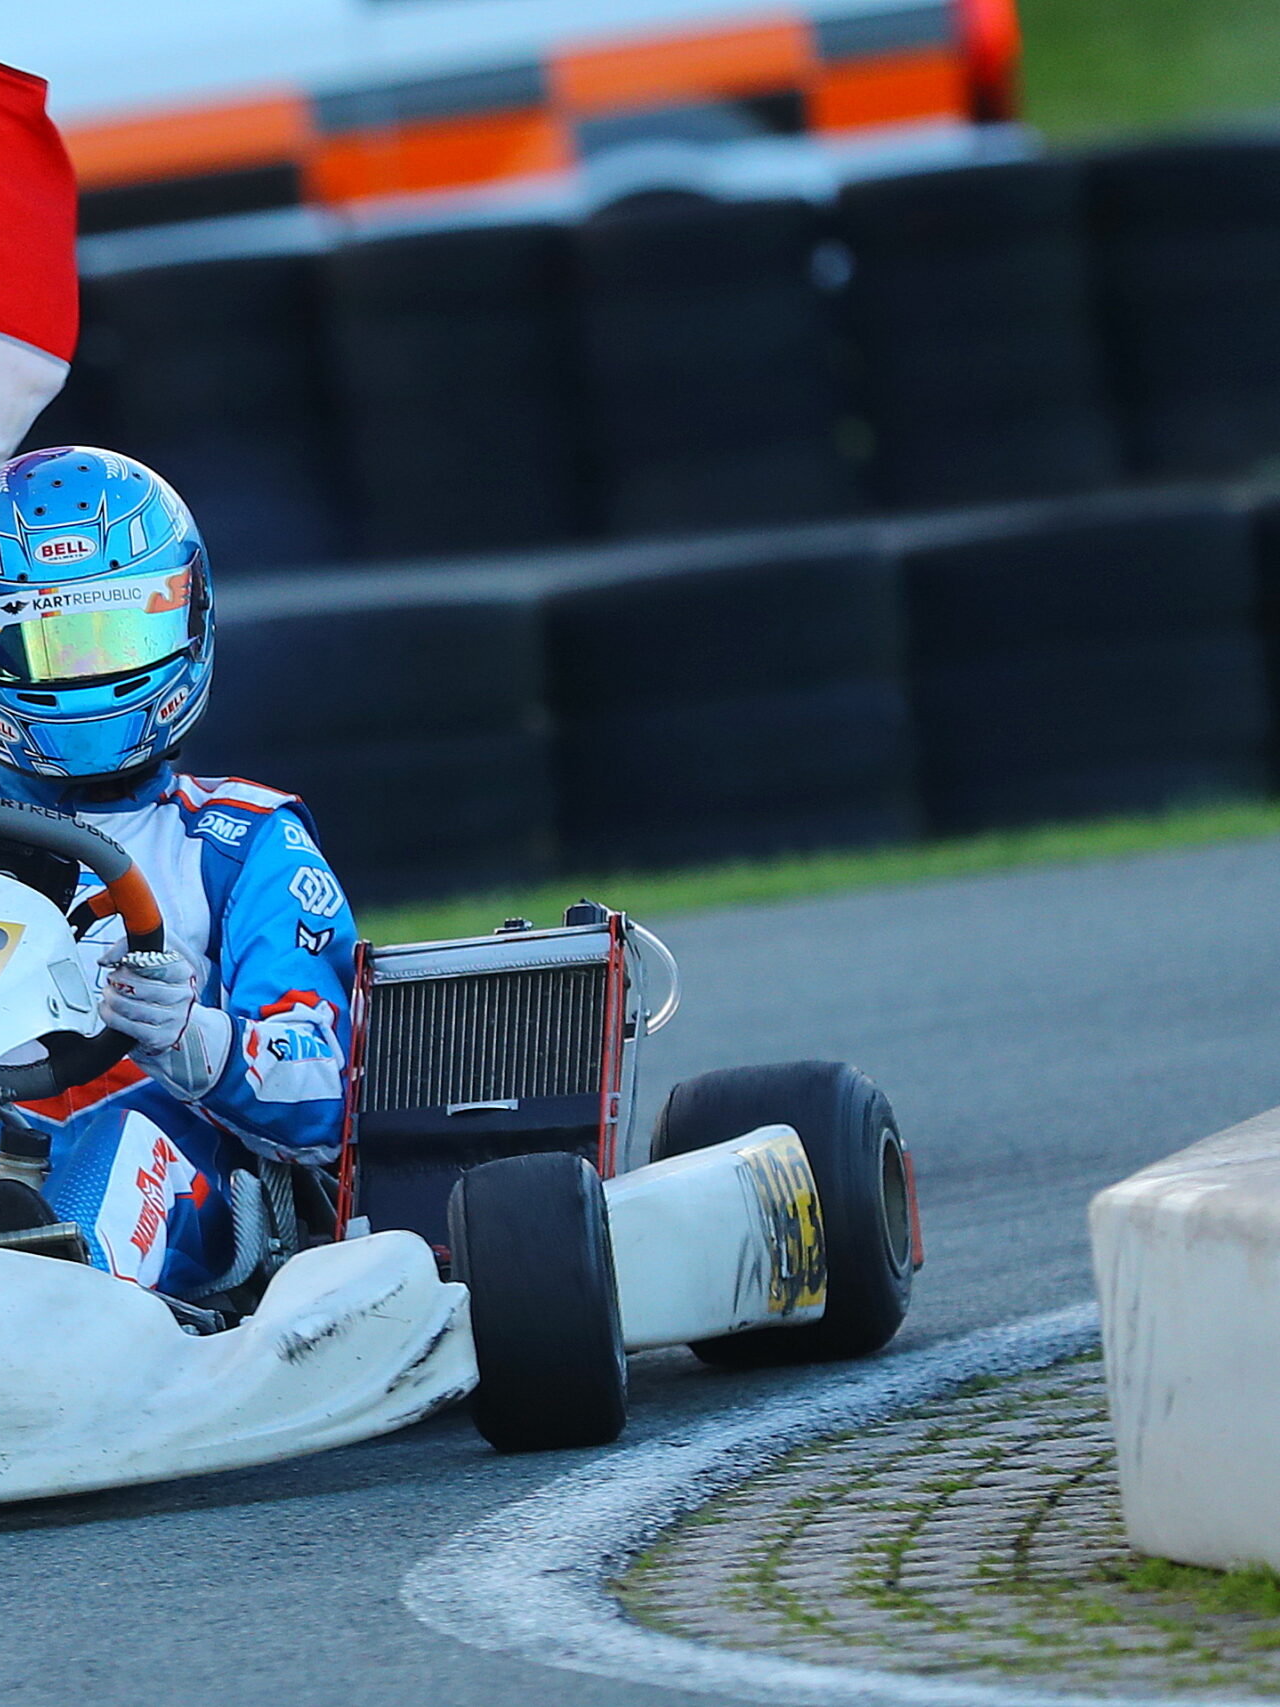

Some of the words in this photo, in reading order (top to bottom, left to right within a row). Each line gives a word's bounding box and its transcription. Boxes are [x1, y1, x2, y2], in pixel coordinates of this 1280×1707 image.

[41, 541, 89, 558] BELL
[32, 587, 142, 610] KARTREPUBLIC
[159, 692, 186, 720] BELL
[197, 815, 248, 840] OMP
